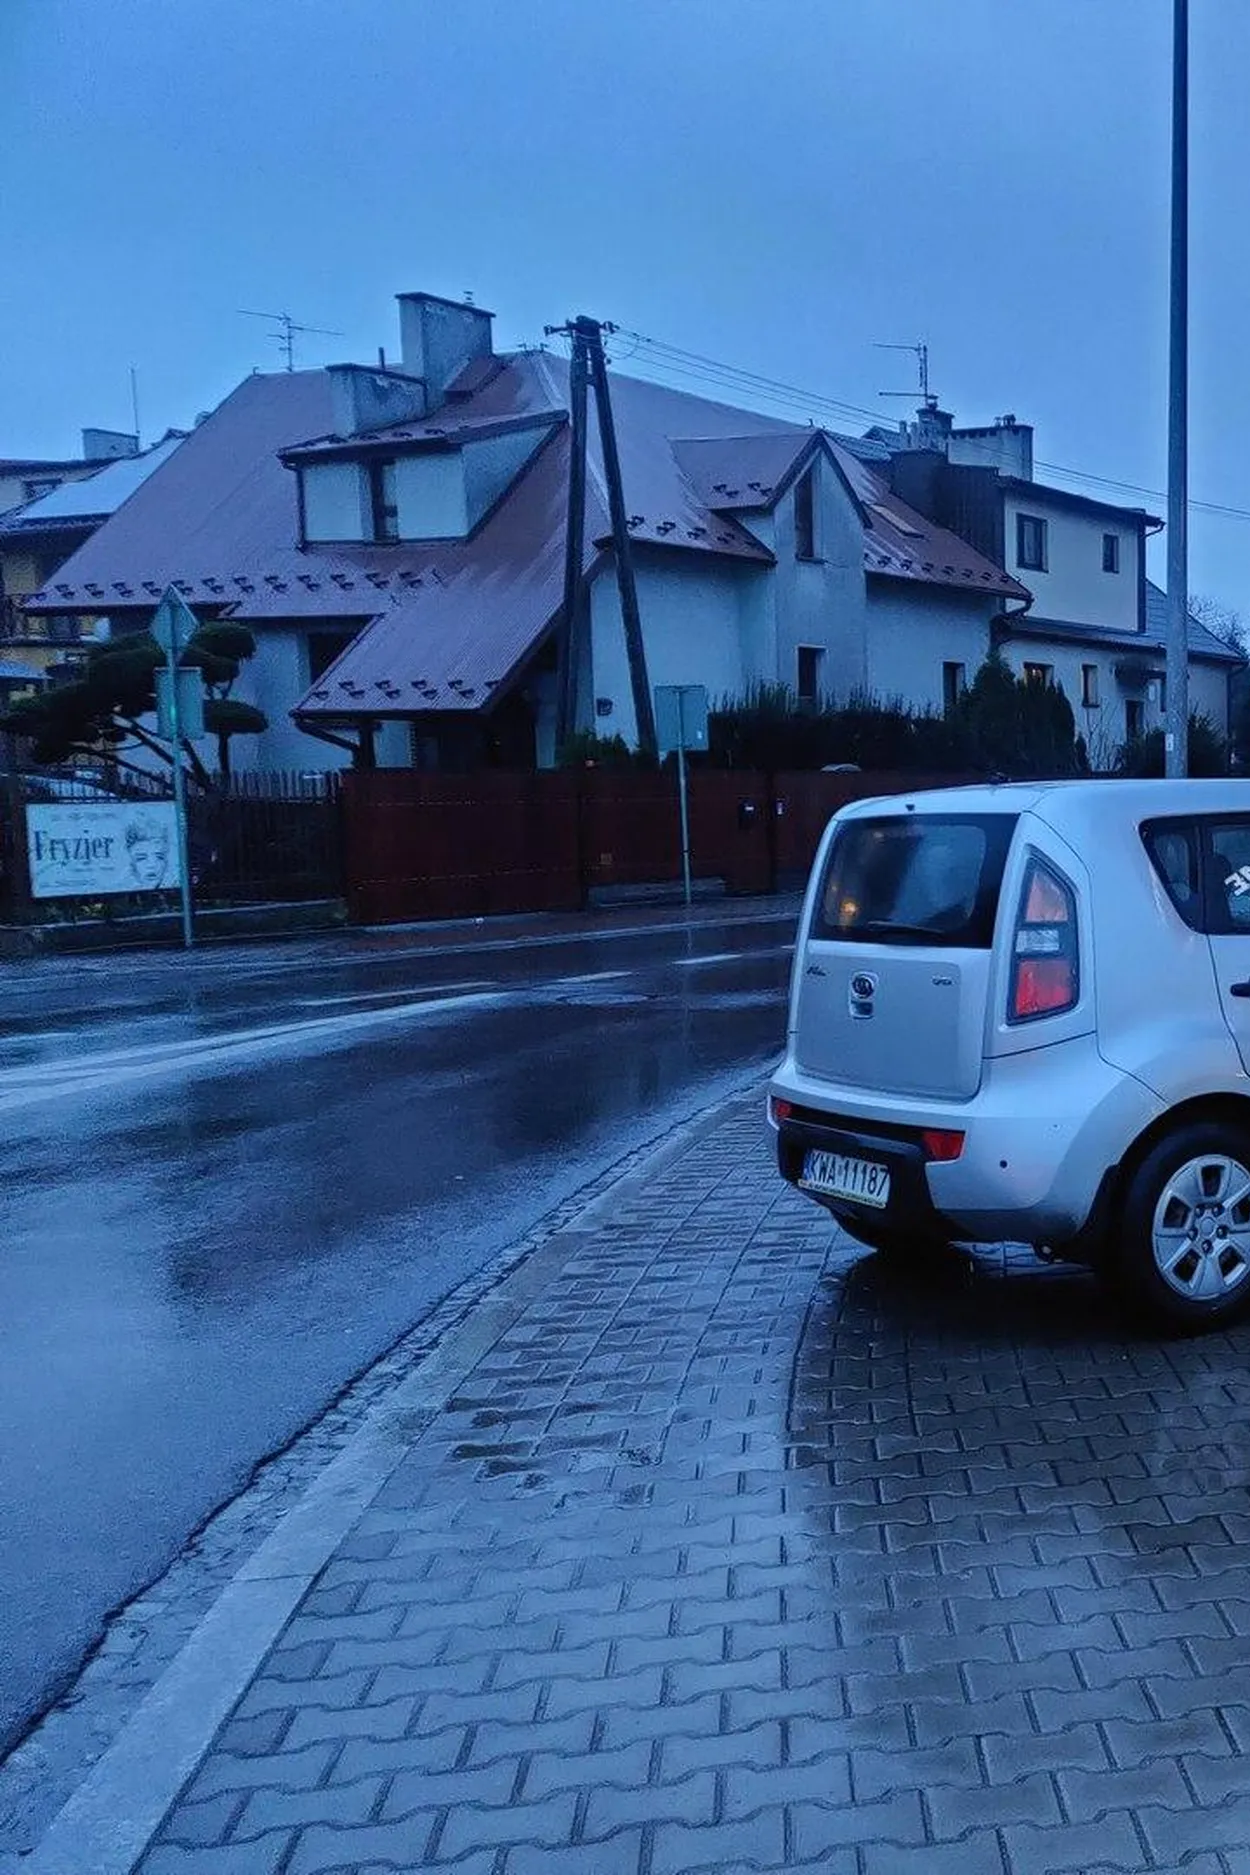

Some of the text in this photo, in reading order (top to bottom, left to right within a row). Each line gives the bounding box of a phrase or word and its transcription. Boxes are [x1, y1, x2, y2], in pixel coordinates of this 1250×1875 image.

[34, 829, 114, 866] Fryzjer
[810, 1152, 836, 1186] KWA
[843, 1159, 888, 1197] 11187
